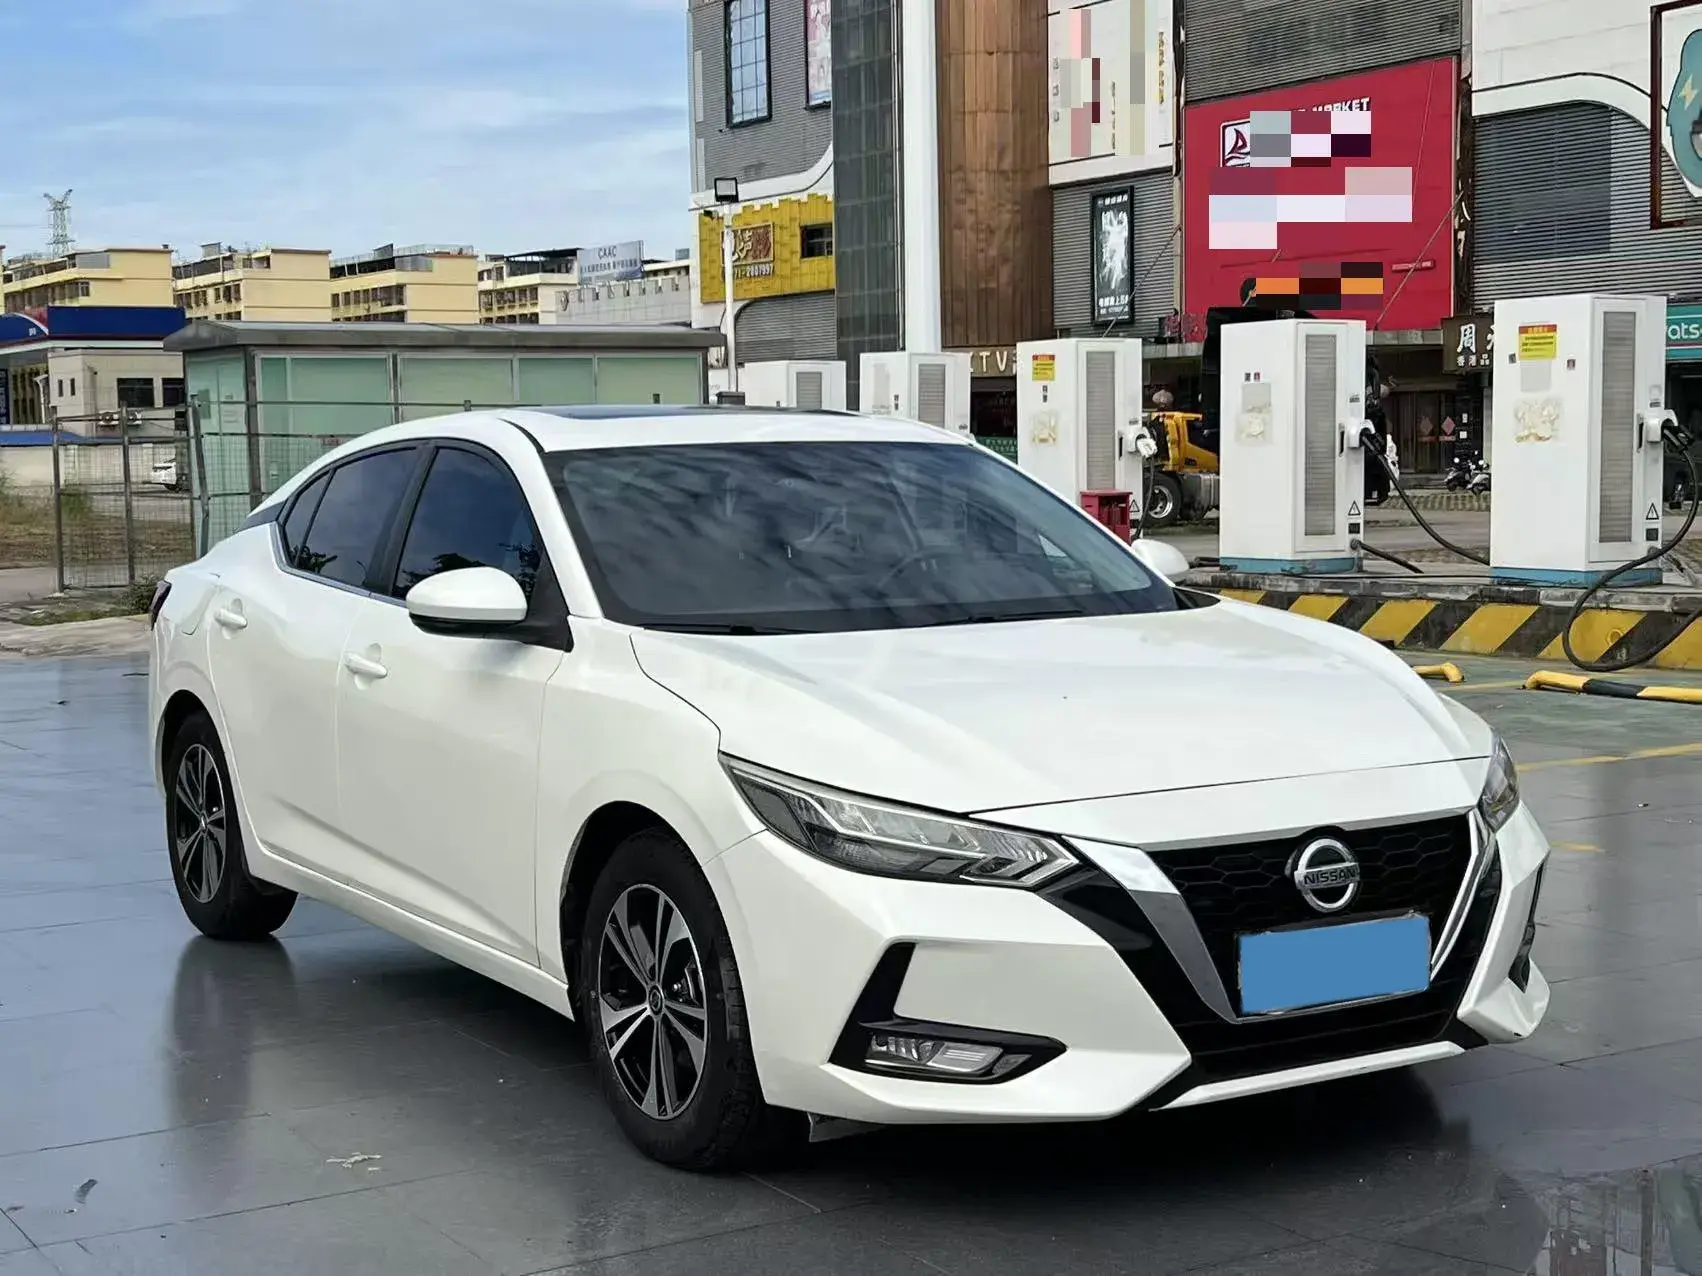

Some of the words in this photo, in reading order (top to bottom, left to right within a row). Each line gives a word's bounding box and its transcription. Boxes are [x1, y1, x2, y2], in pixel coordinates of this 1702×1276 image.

[597, 245, 617, 259] CAAC
[1667, 322, 1702, 339] ats
[970, 350, 1008, 373] TV
[1304, 869, 1357, 885] NISSAN
